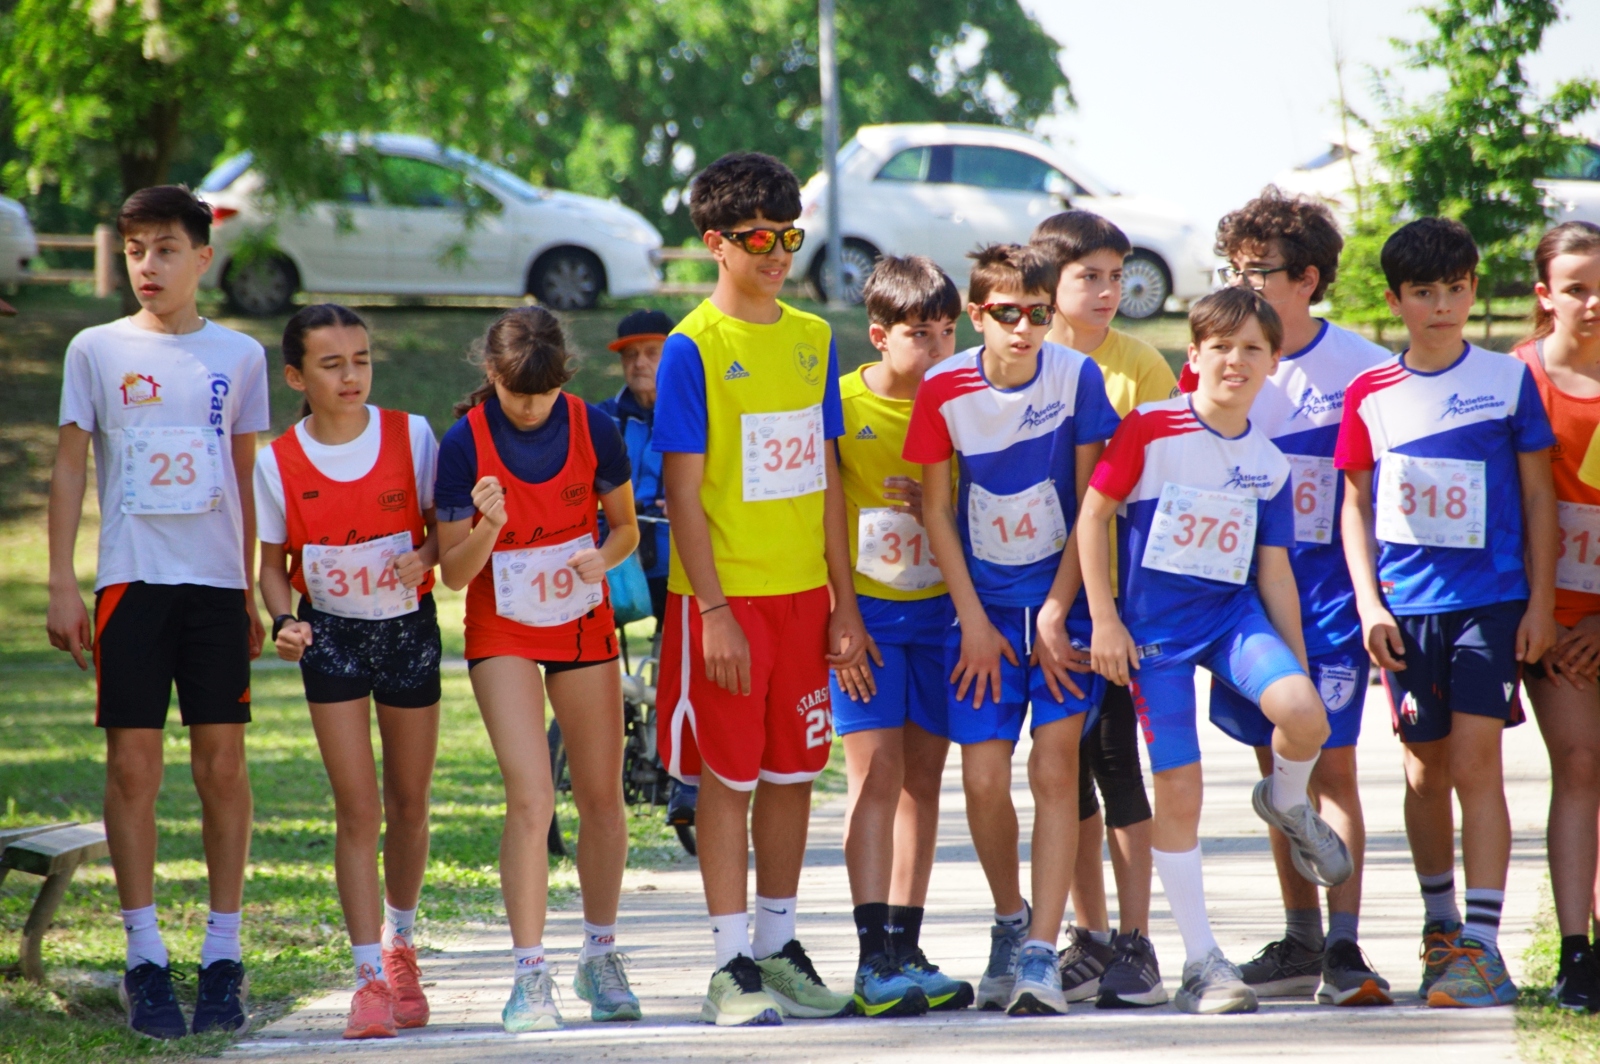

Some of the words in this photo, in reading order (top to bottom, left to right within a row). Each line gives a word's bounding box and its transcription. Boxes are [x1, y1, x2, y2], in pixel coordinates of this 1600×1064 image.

[1312, 401, 1343, 414] Caste
[1458, 395, 1495, 407] Atletica
[1458, 401, 1505, 415] Castenaso
[763, 433, 816, 473] 324
[149, 452, 196, 486] 23
[382, 492, 404, 504] LUCCI
[565, 485, 586, 499] LUCCI
[1398, 482, 1467, 519] 318
[992, 513, 1037, 543] 14
[1173, 513, 1240, 553] 376
[880, 532, 939, 567] 31
[326, 566, 399, 598] 314
[531, 568, 573, 603] 19
[796, 686, 829, 716] STARS
